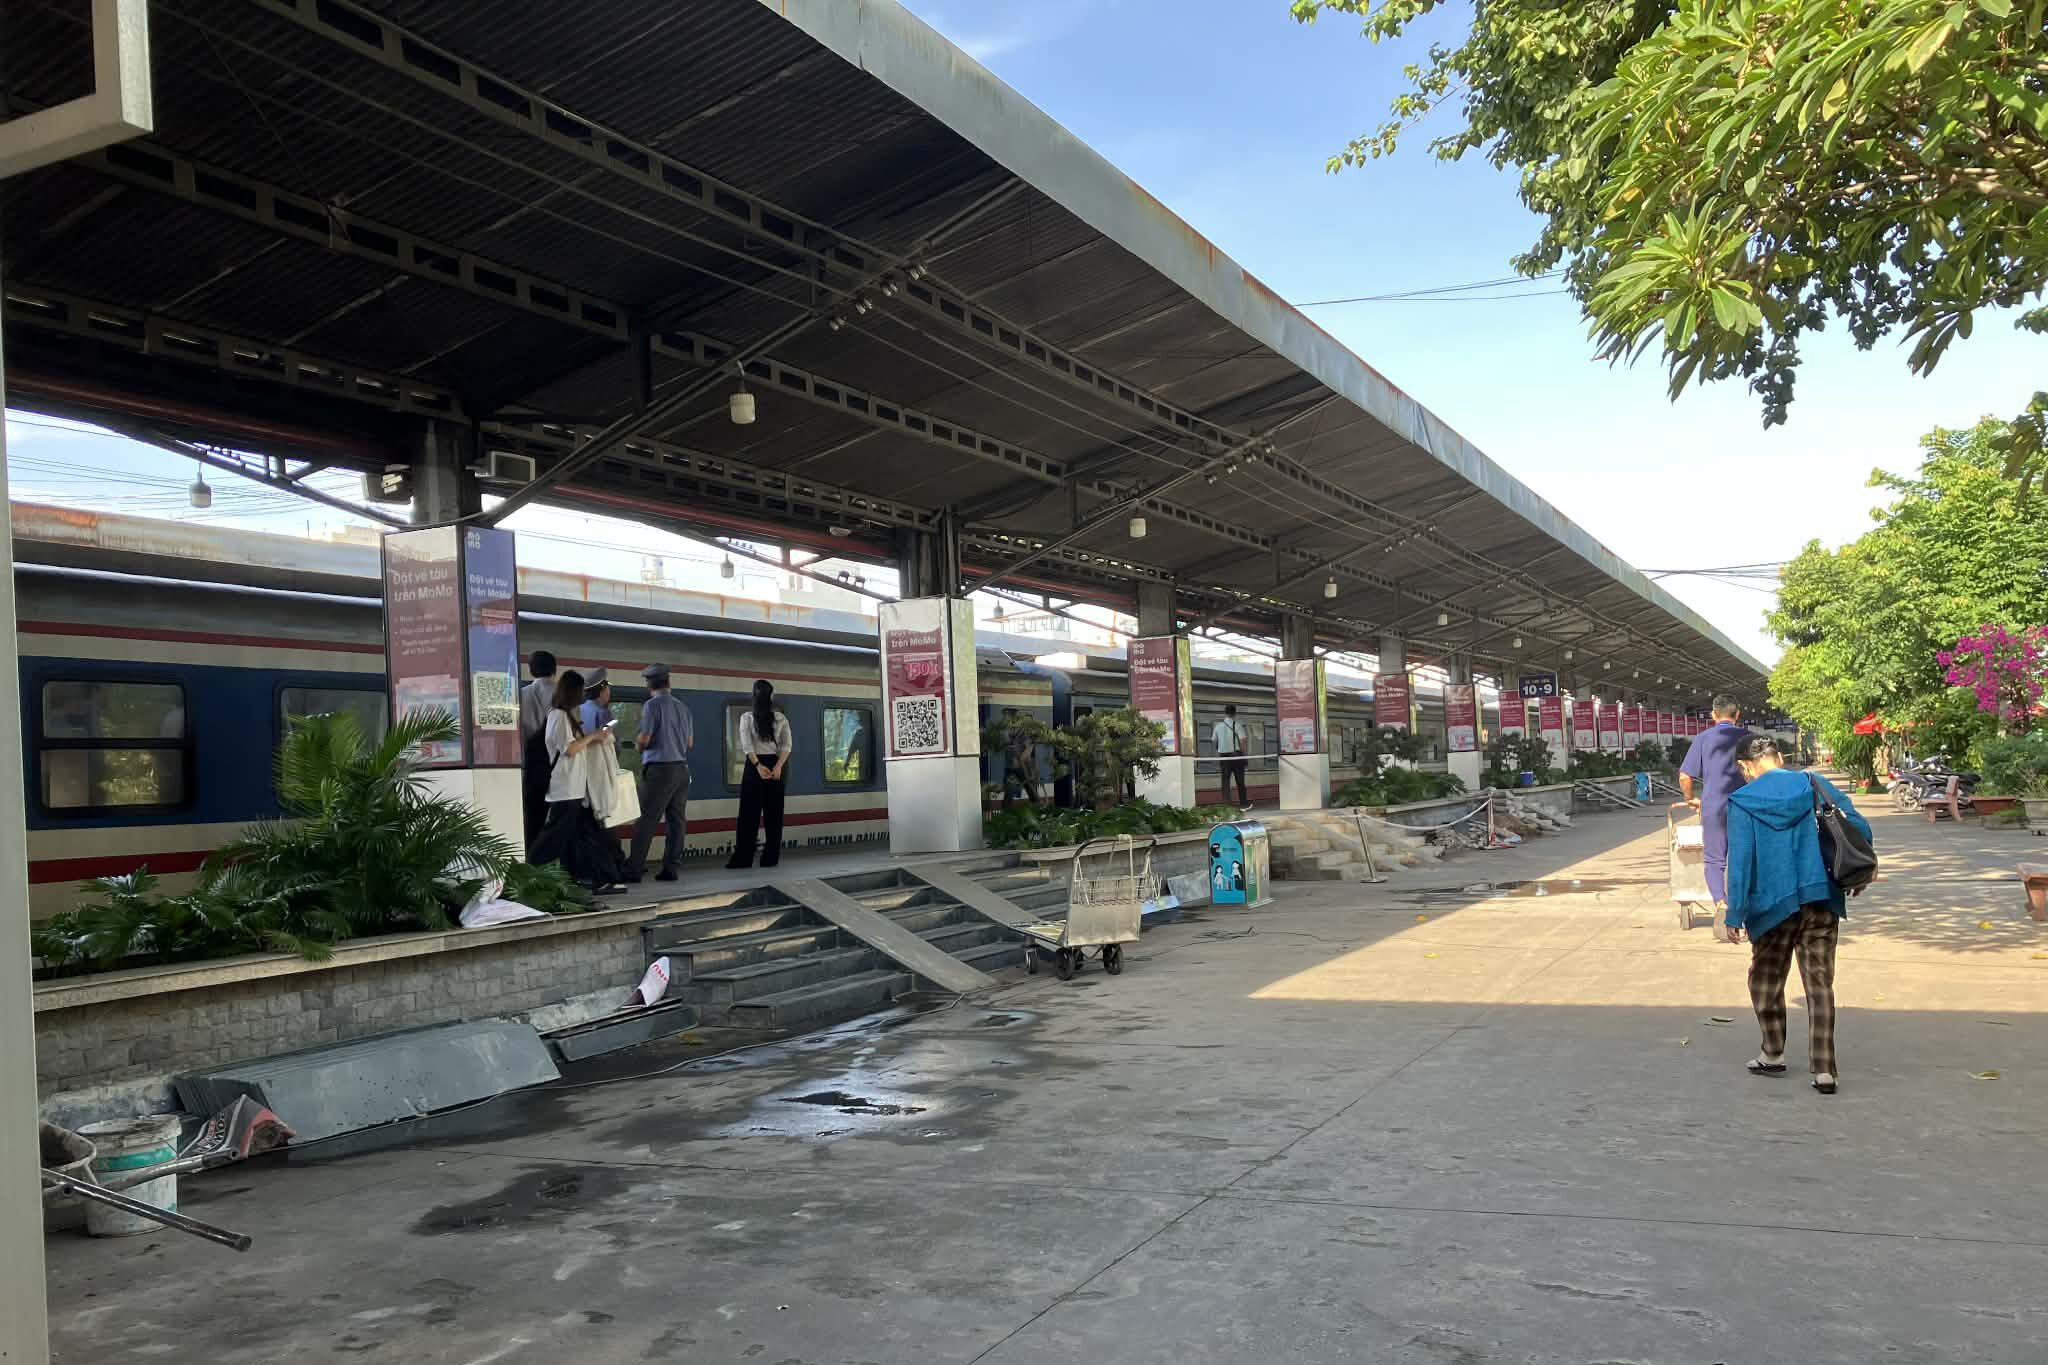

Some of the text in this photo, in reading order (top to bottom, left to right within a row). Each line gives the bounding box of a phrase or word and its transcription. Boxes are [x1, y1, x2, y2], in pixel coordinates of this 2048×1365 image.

[393, 567, 448, 586] Đặt vé tàu
[418, 584, 453, 600] MoMo
[910, 637, 936, 646] MoMo
